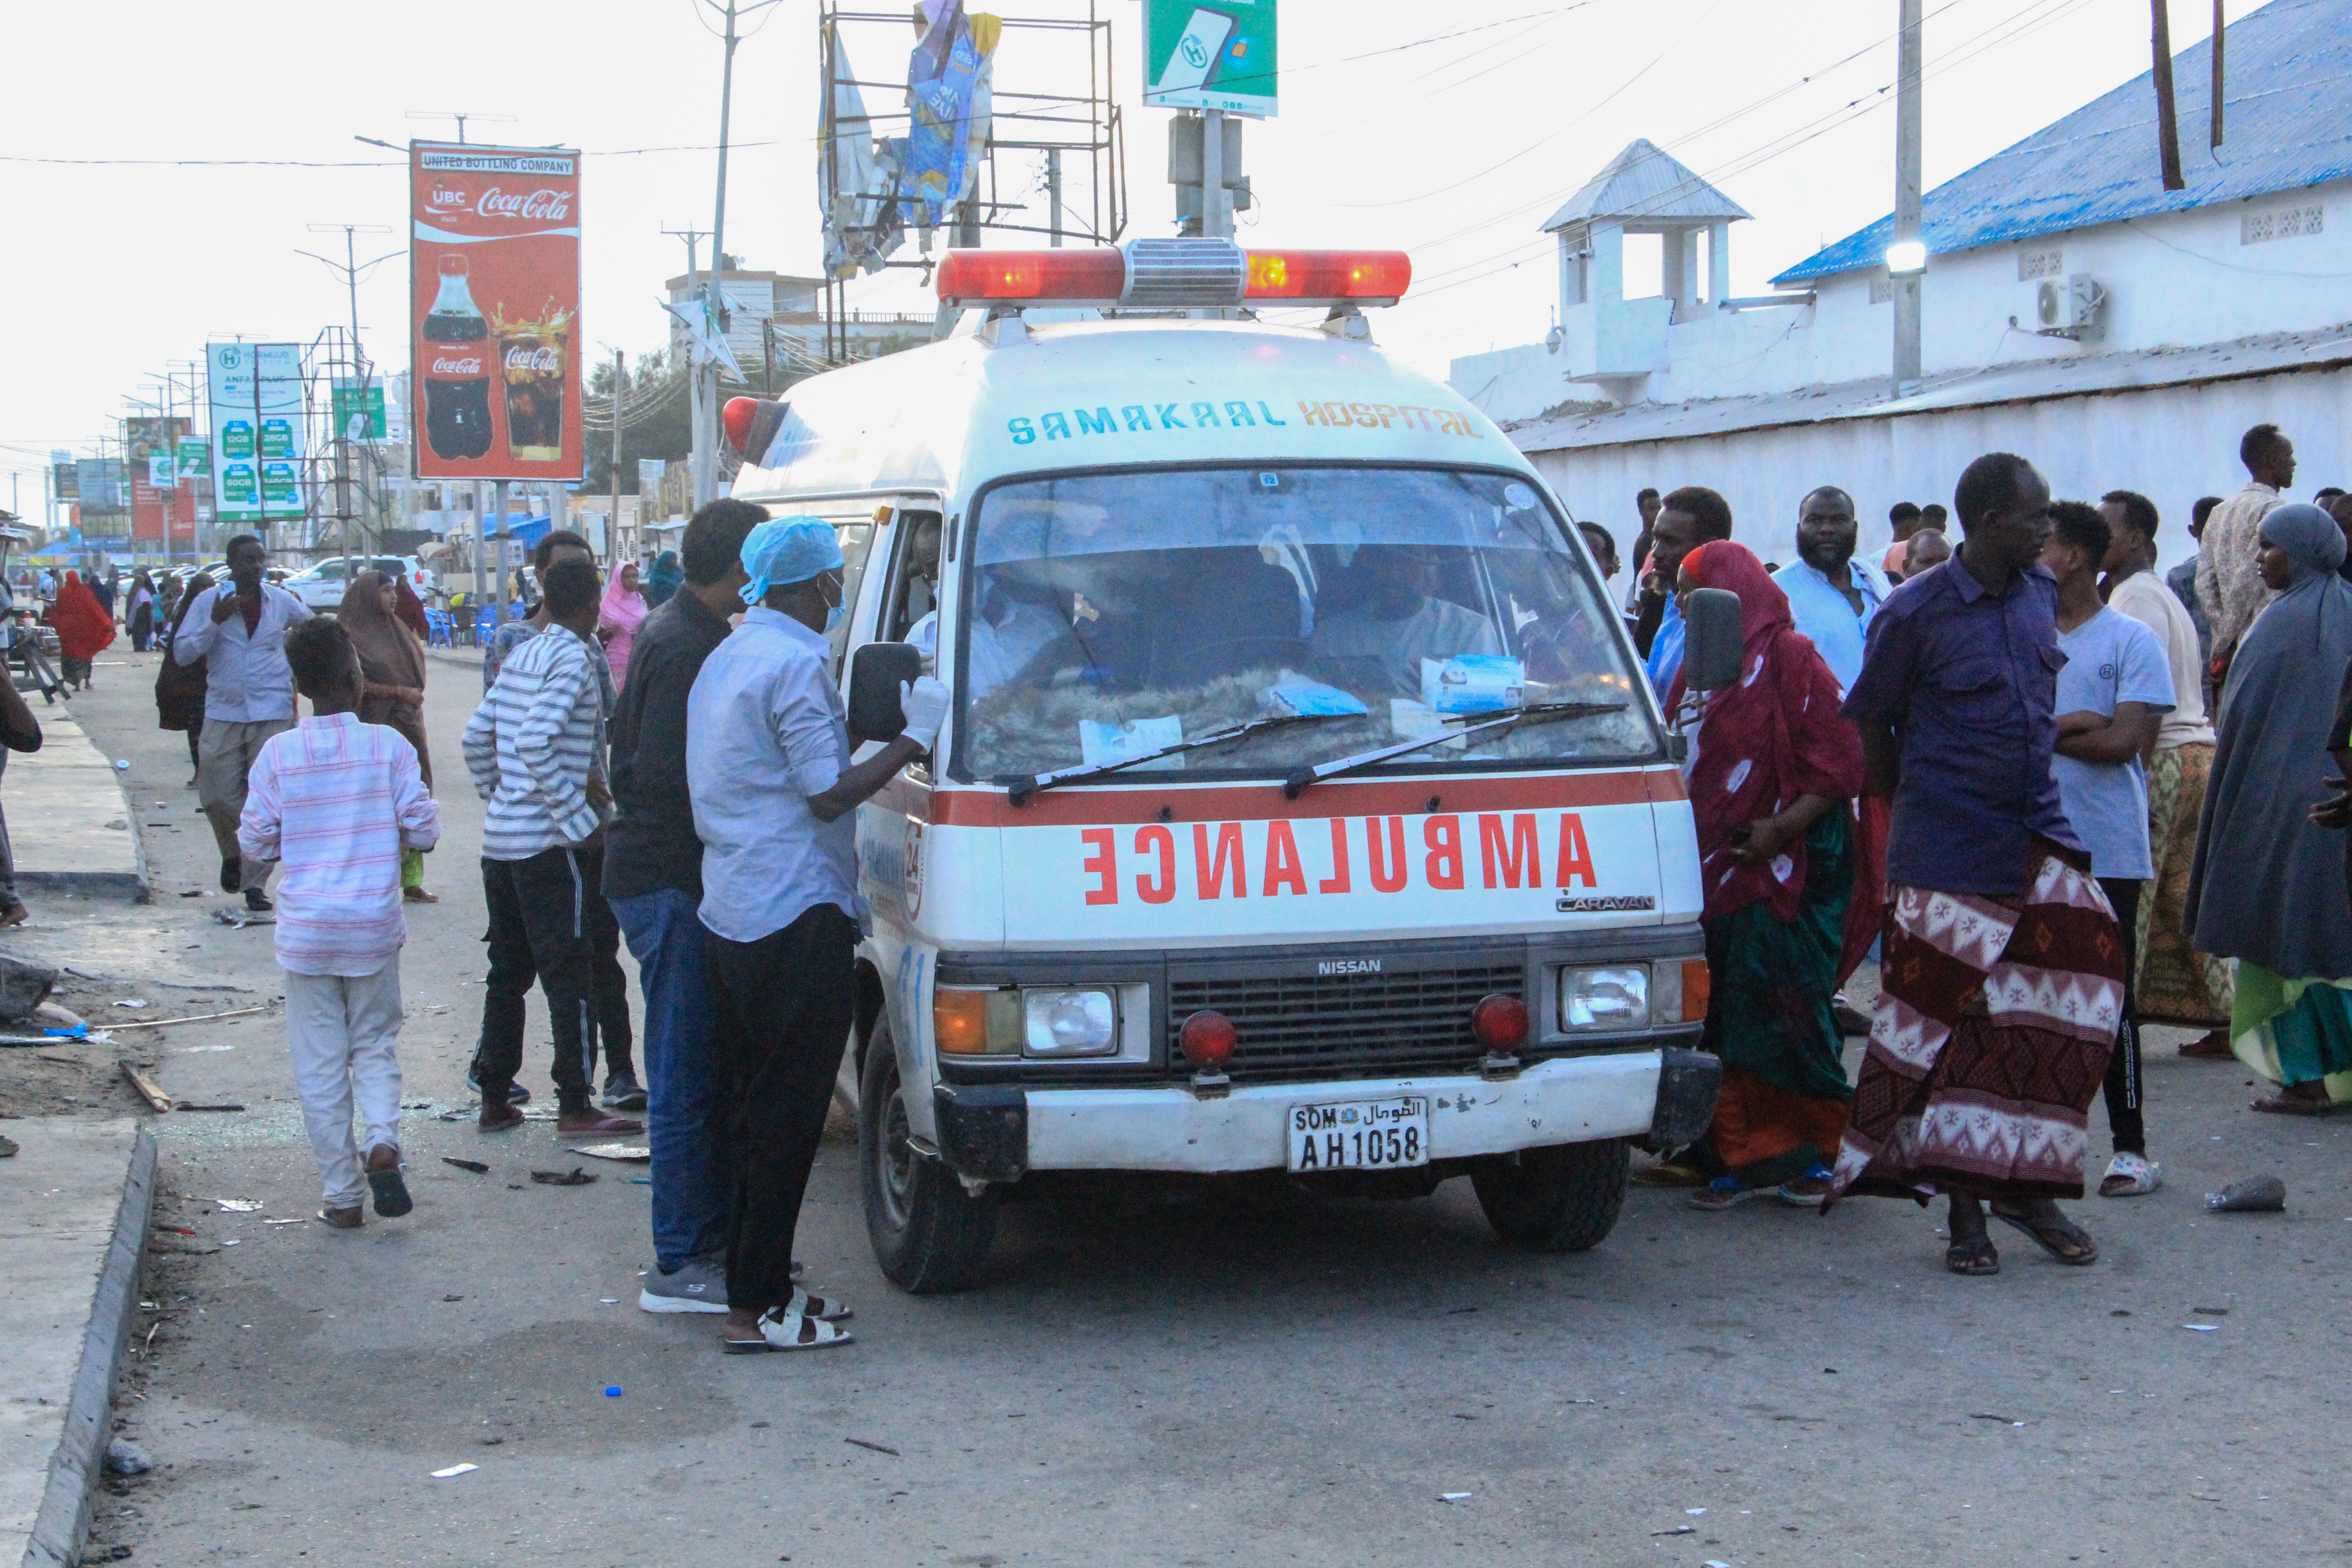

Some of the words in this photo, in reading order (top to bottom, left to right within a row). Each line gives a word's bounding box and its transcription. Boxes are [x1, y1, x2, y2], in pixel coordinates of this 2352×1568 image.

[424, 156, 463, 167] UNITED
[466, 157, 517, 170] BOTTLING
[521, 160, 571, 173] COMPANY
[433, 191, 466, 204] UBC
[477, 186, 573, 220] Coca-Cola
[432, 358, 482, 374] Coca-Cola
[506, 346, 559, 371] Coca-Cola
[1007, 401, 1286, 445] SAMAKAAL
[1297, 401, 1485, 439] HOSPITAL
[1557, 896, 1655, 912] CARAVAN
[1318, 960, 1381, 975] NISSAN
[1295, 1107, 1338, 1131] SOM
[1363, 1102, 1421, 1124] الصومال
[1301, 1126, 1419, 1169] AH1058
